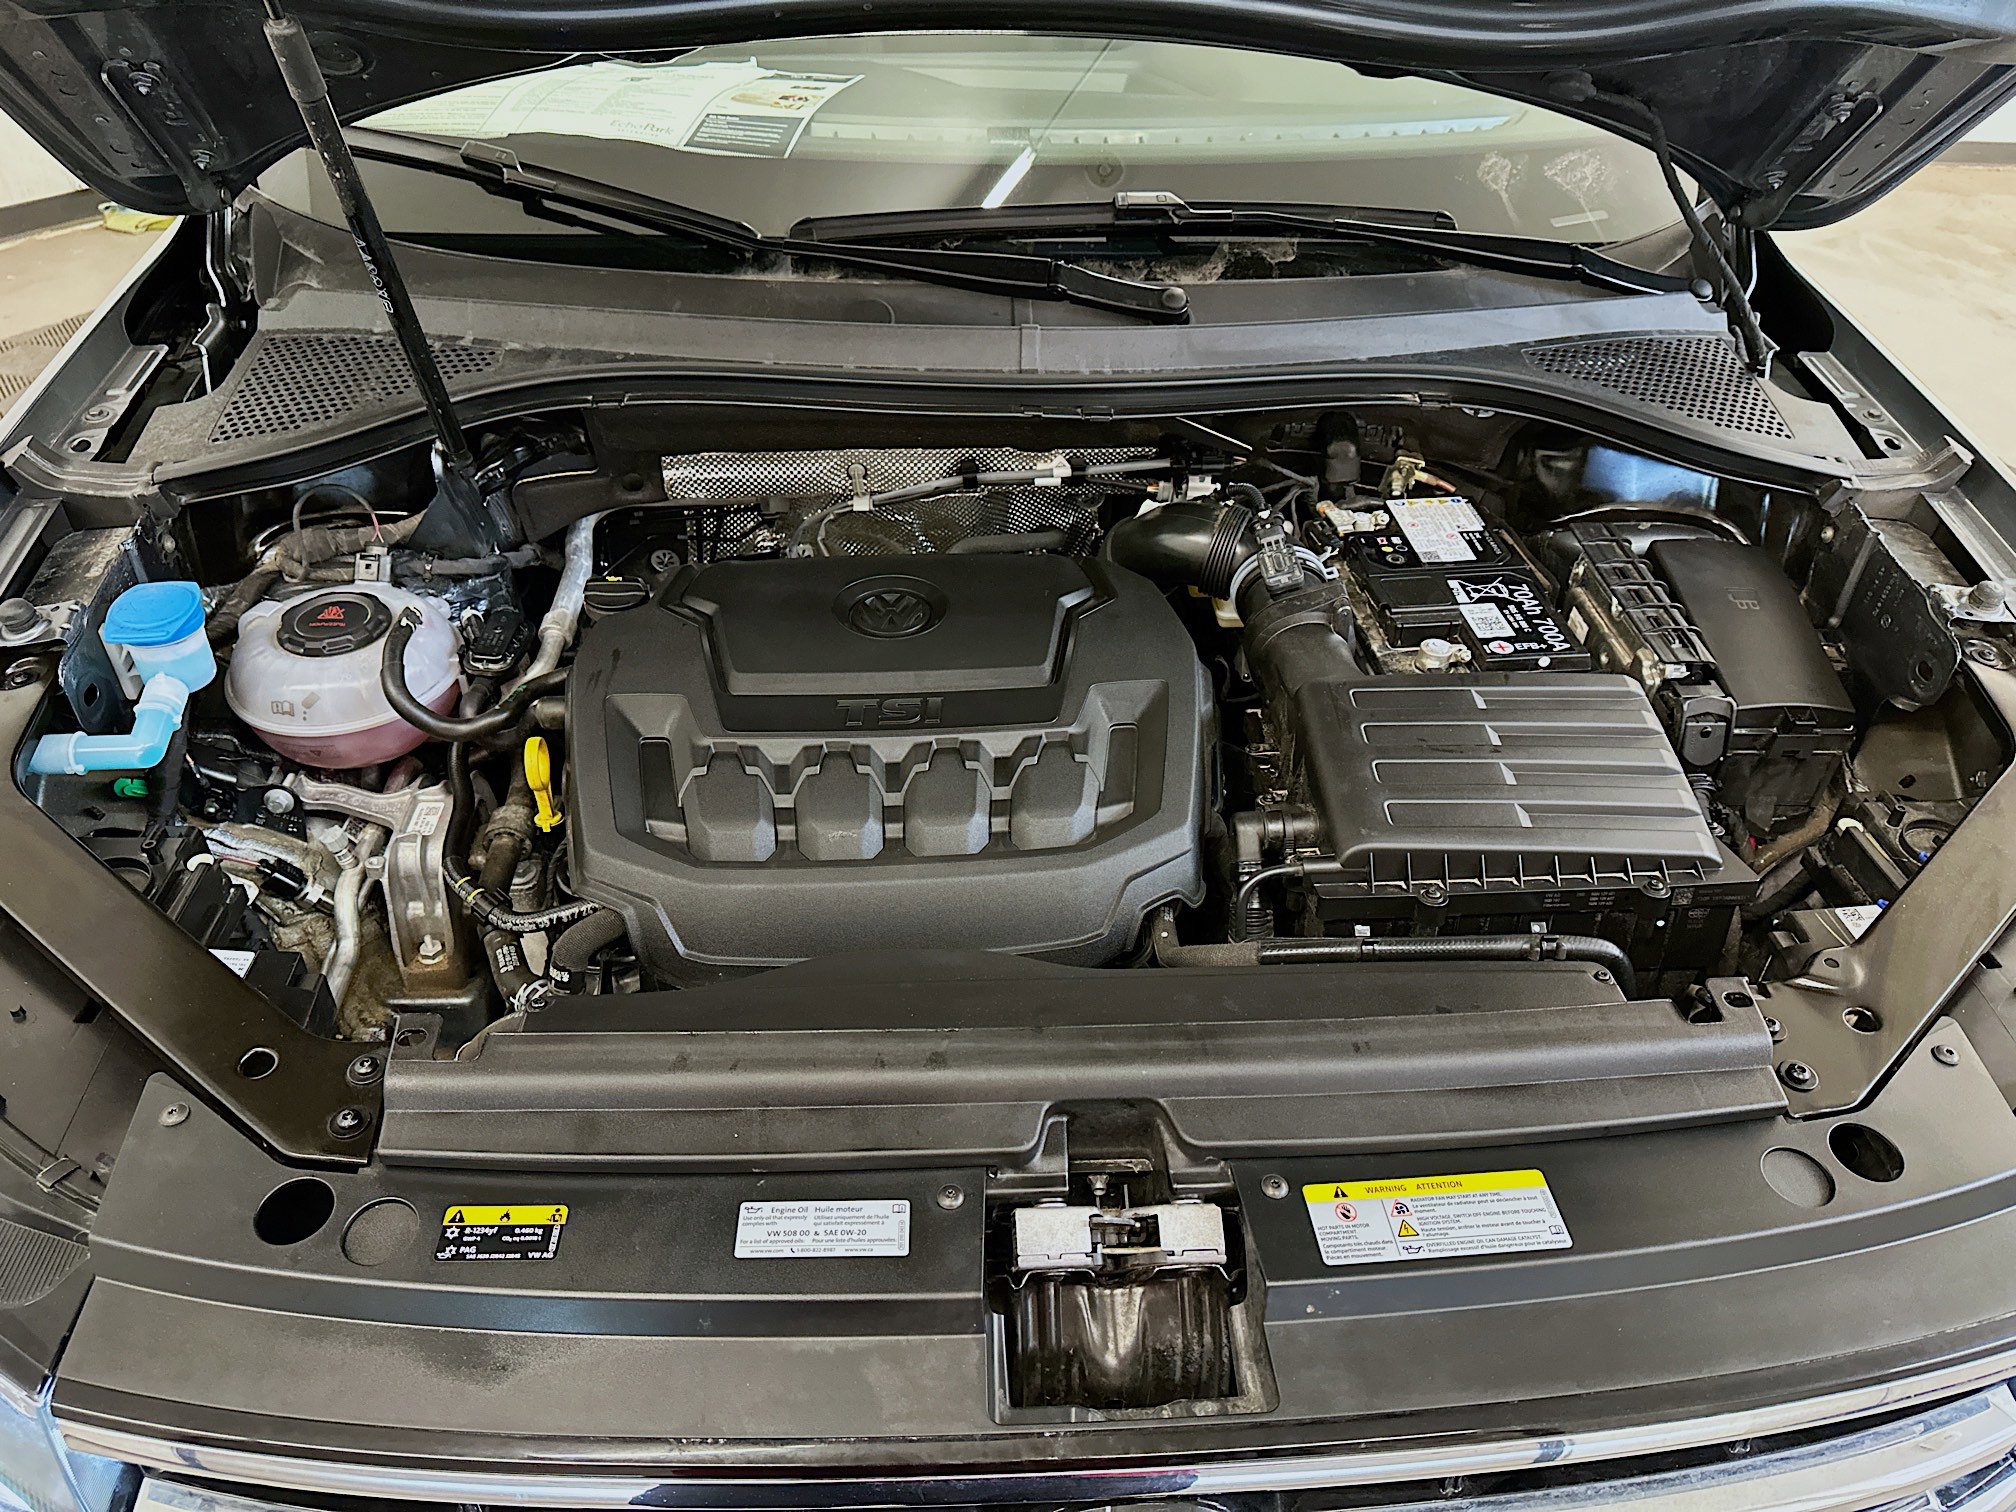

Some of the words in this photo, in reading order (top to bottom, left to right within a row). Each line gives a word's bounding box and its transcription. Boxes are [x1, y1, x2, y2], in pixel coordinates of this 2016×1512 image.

[1508, 583, 1543, 615] 70Ah
[1532, 617, 1571, 652] 700A
[1513, 642, 1547, 650] EFB+
[837, 697, 944, 726] TSI
[1365, 1184, 1407, 1193] WARNING
[1416, 1181, 1463, 1190] ATTENTION
[534, 1227, 543, 1235] kg
[459, 1245, 477, 1254] PAG
[528, 1251, 542, 1259] VW
[541, 1251, 554, 1259] AG
